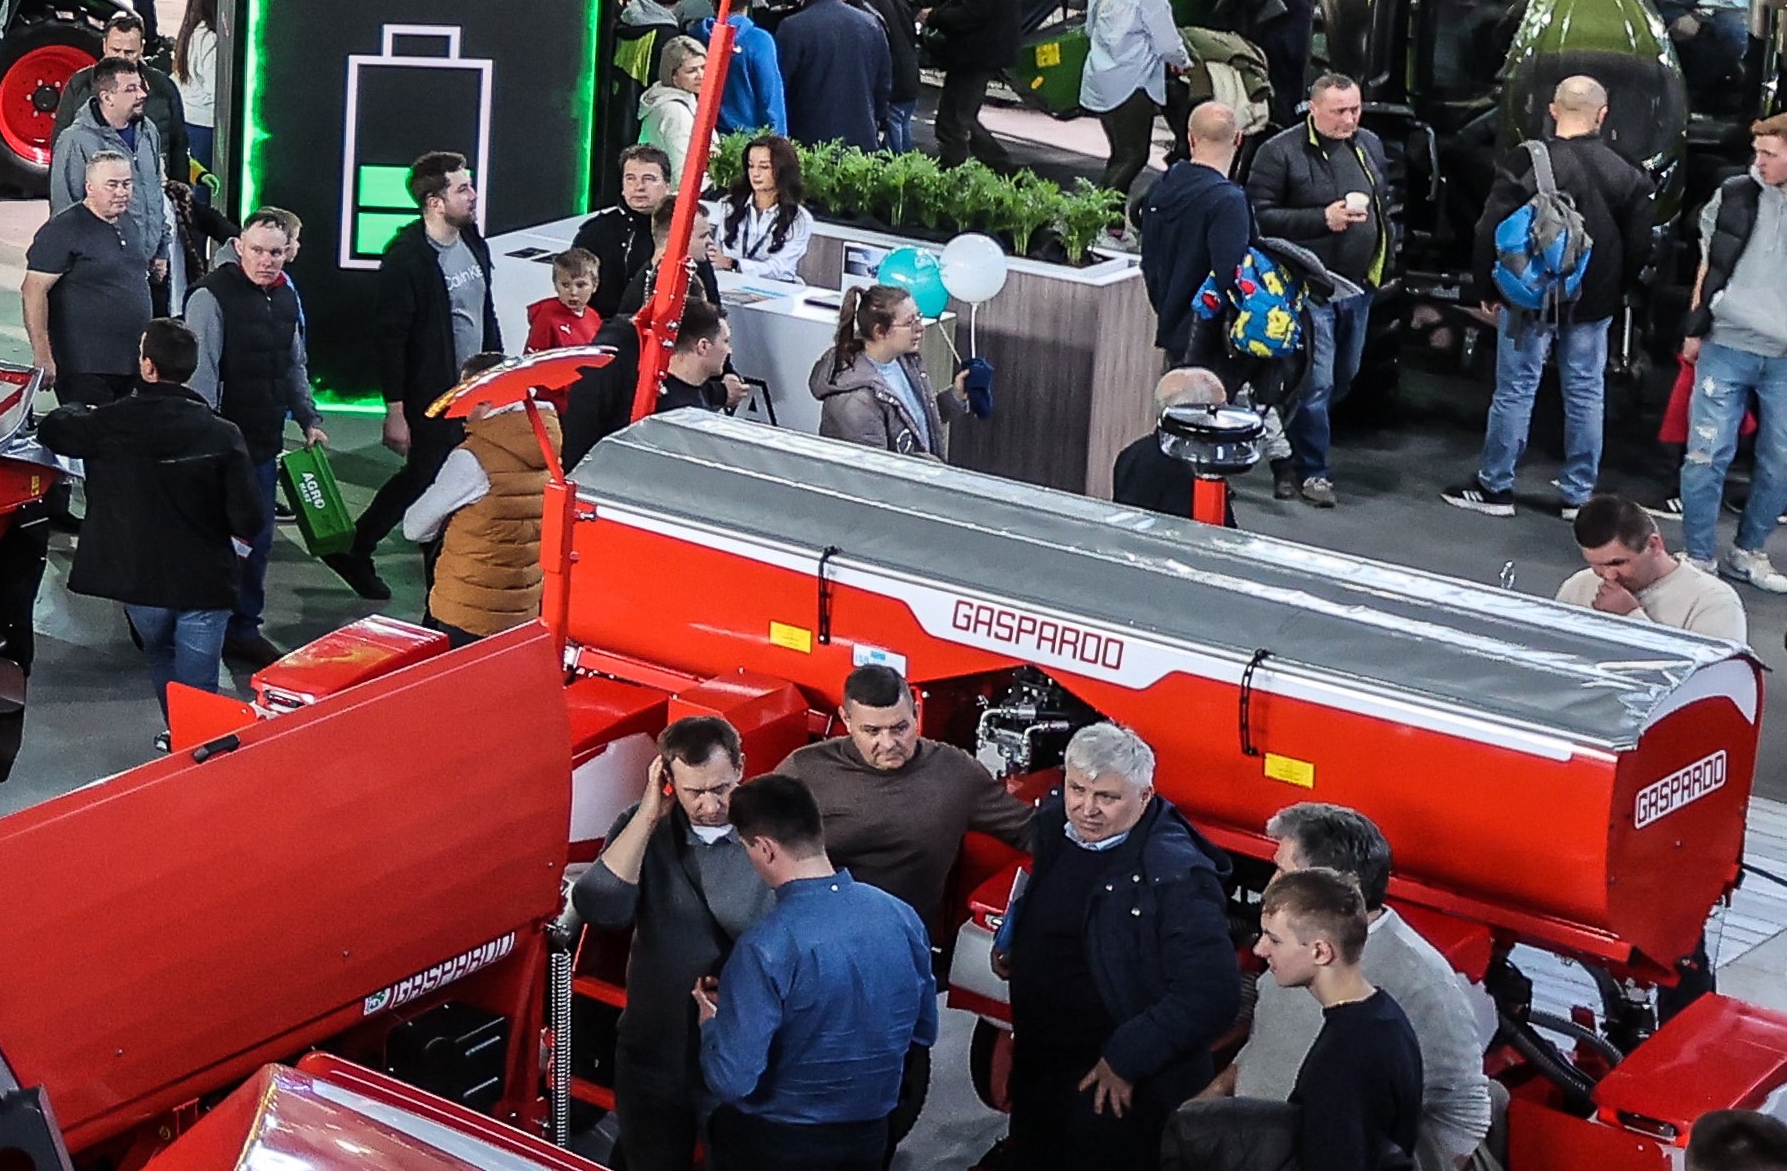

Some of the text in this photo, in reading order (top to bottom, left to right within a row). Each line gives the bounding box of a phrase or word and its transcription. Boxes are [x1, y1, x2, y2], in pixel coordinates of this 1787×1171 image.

[301, 471, 326, 510] AGRO
[952, 598, 1124, 671] GASPARDO
[1637, 754, 1725, 824] GASPARDO
